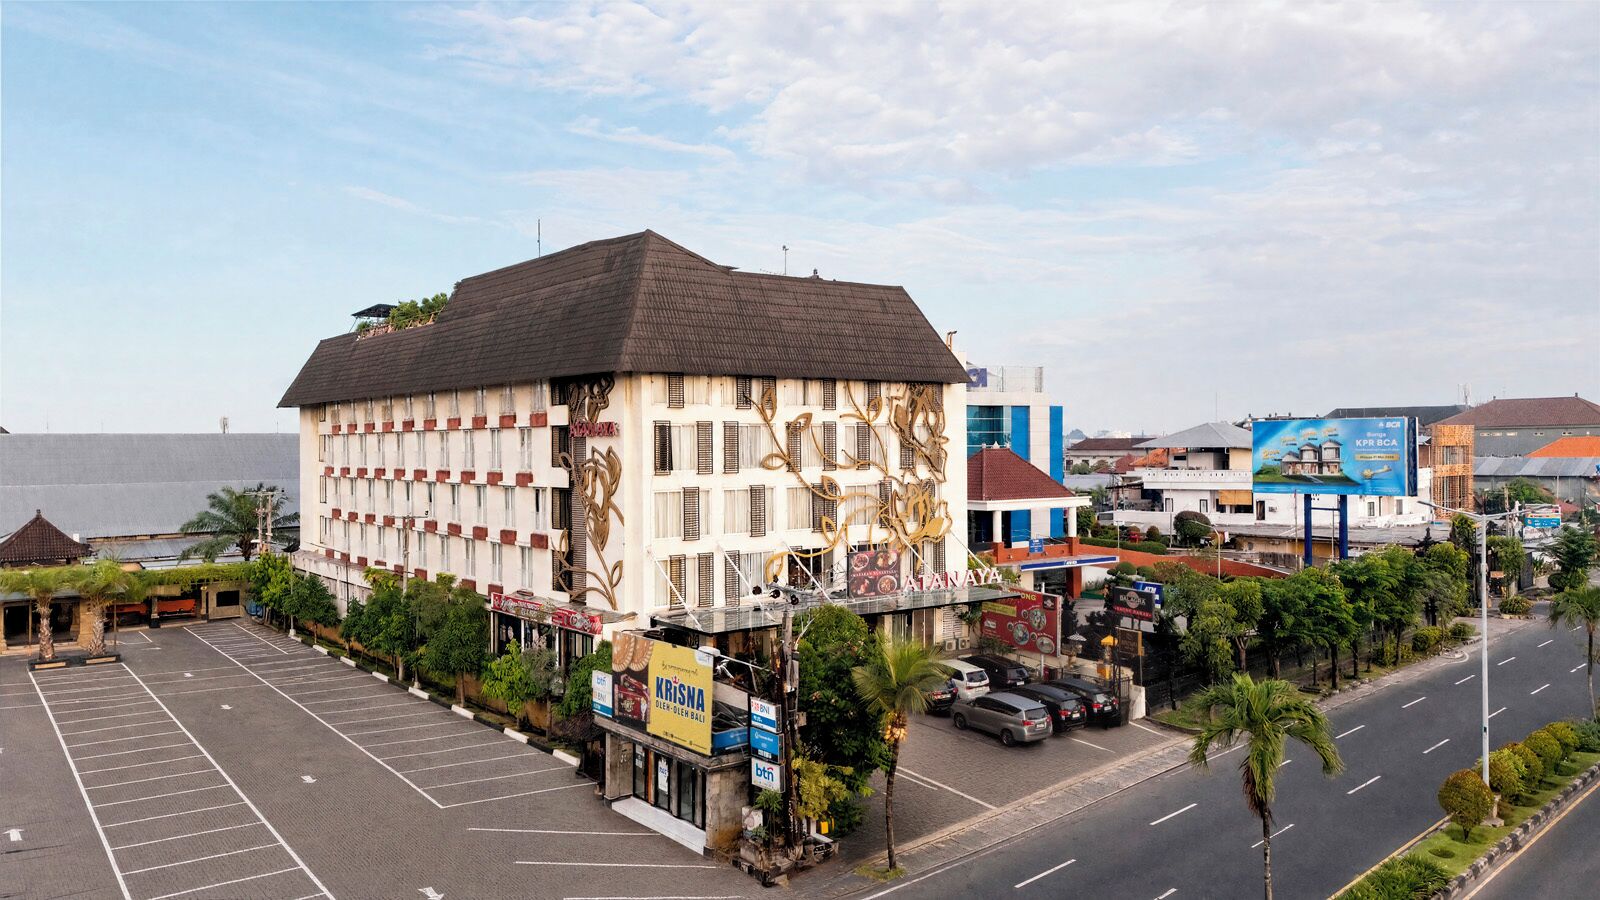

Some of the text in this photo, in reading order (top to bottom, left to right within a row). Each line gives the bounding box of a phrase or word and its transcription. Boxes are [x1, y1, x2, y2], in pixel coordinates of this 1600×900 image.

[1355, 439, 1398, 447] KPR BCA
[903, 567, 1003, 593] ATANAYA
[760, 703, 770, 715] BNI
[690, 712, 706, 724] BALI
[755, 762, 774, 782] btn
